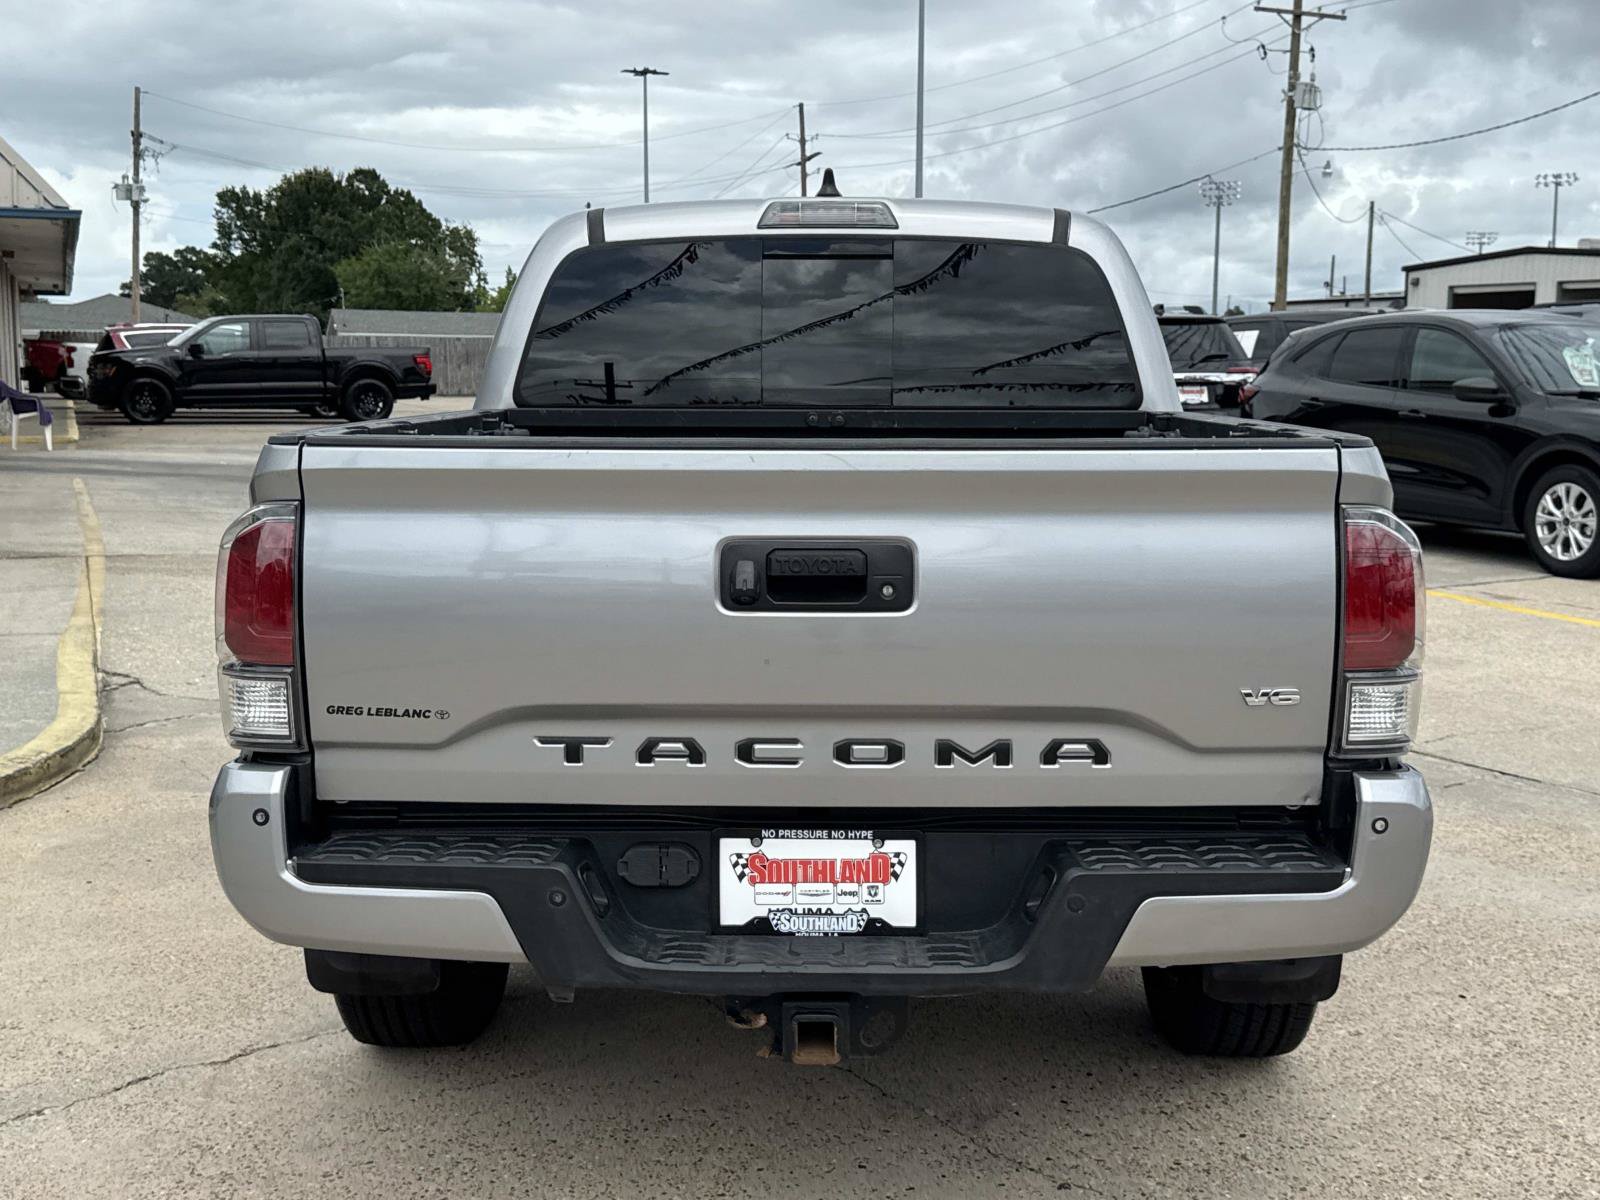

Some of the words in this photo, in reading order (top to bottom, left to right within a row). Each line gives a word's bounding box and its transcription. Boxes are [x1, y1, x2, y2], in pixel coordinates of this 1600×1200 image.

[775, 556, 857, 575] TOYOTA
[1240, 688, 1301, 706] V6
[326, 705, 364, 716] GREG
[367, 707, 432, 719] LEBLANC
[532, 736, 1113, 768] TACOMA
[761, 829, 776, 838] NO
[778, 829, 829, 839] PRESSURE
[831, 830, 845, 839] NO
[848, 830, 874, 839] HYPE
[747, 853, 892, 885] SOUTHLAND
[837, 889, 858, 898] Jeep
[779, 913, 859, 932] SOUTHLAND
